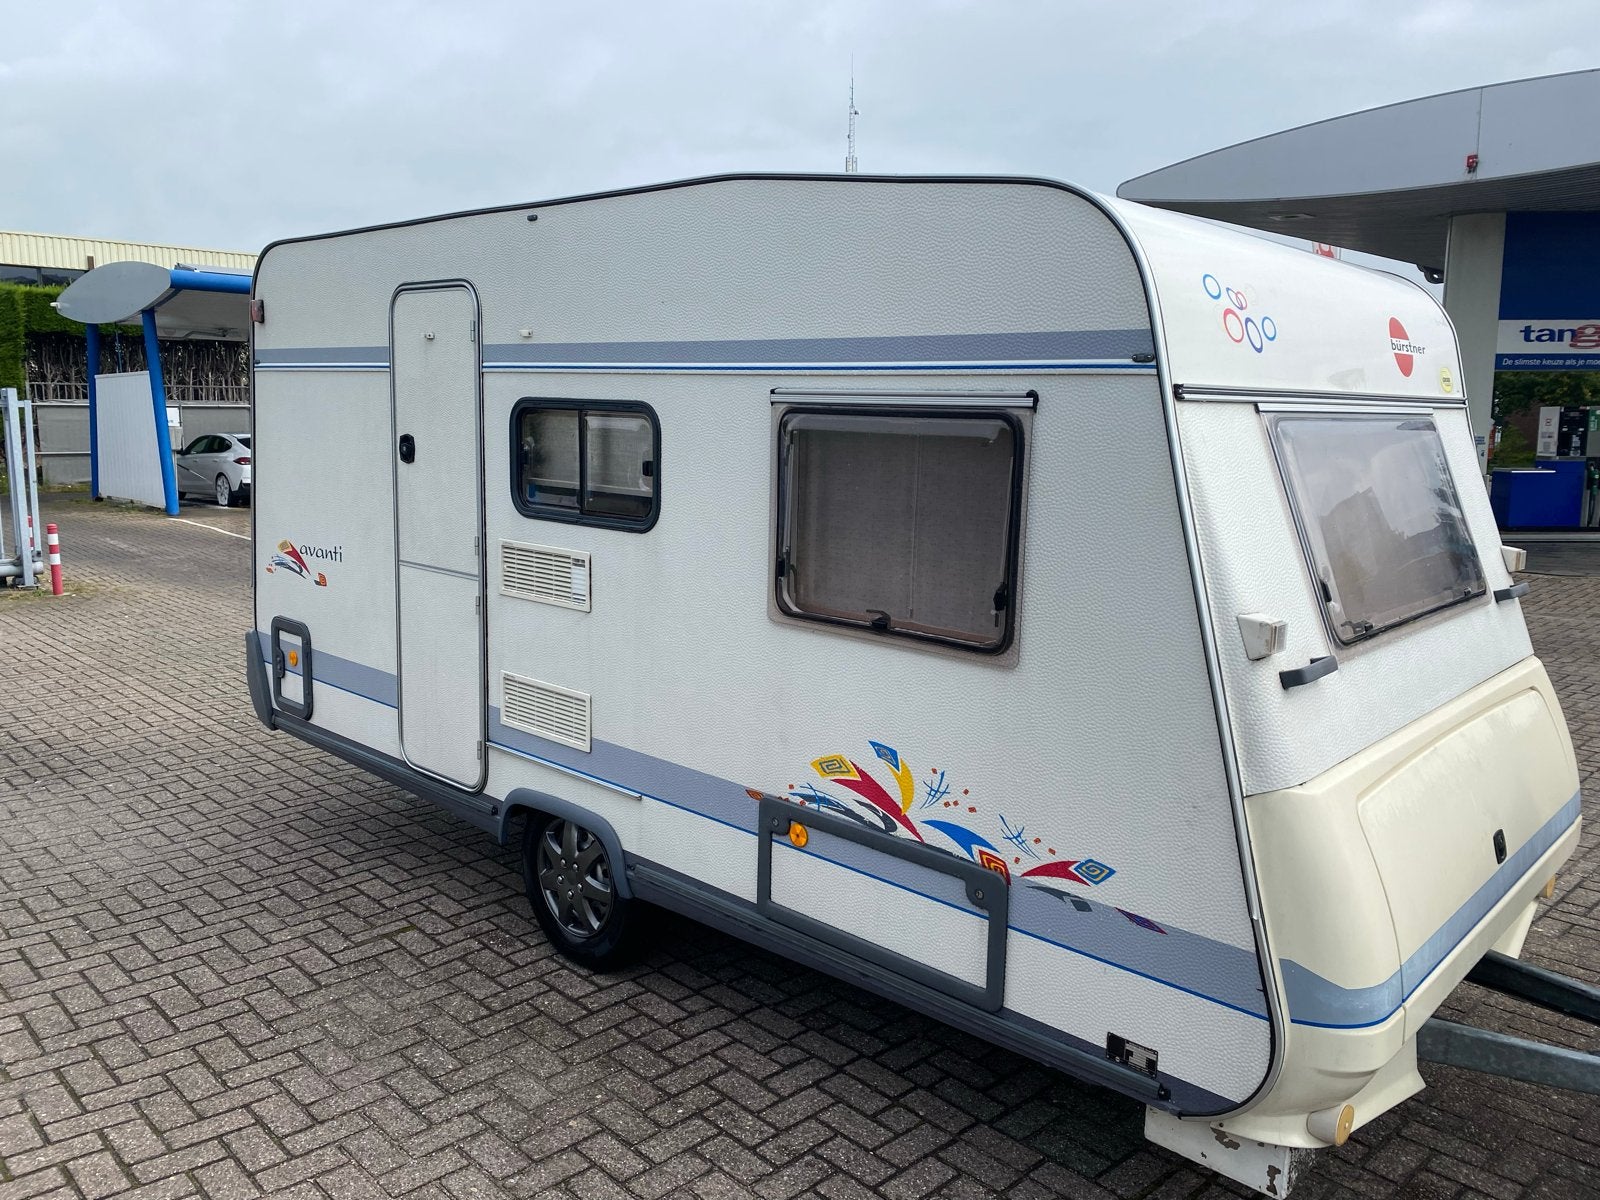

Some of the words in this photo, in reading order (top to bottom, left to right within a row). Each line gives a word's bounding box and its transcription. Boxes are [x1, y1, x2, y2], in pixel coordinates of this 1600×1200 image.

[1390, 339, 1426, 354] bürstner
[1502, 358, 1513, 366] De
[1514, 358, 1541, 366] slimste
[1542, 358, 1565, 366] keuze
[1565, 358, 1577, 366] als
[1576, 358, 1585, 367] je
[299, 544, 343, 562] avanti
